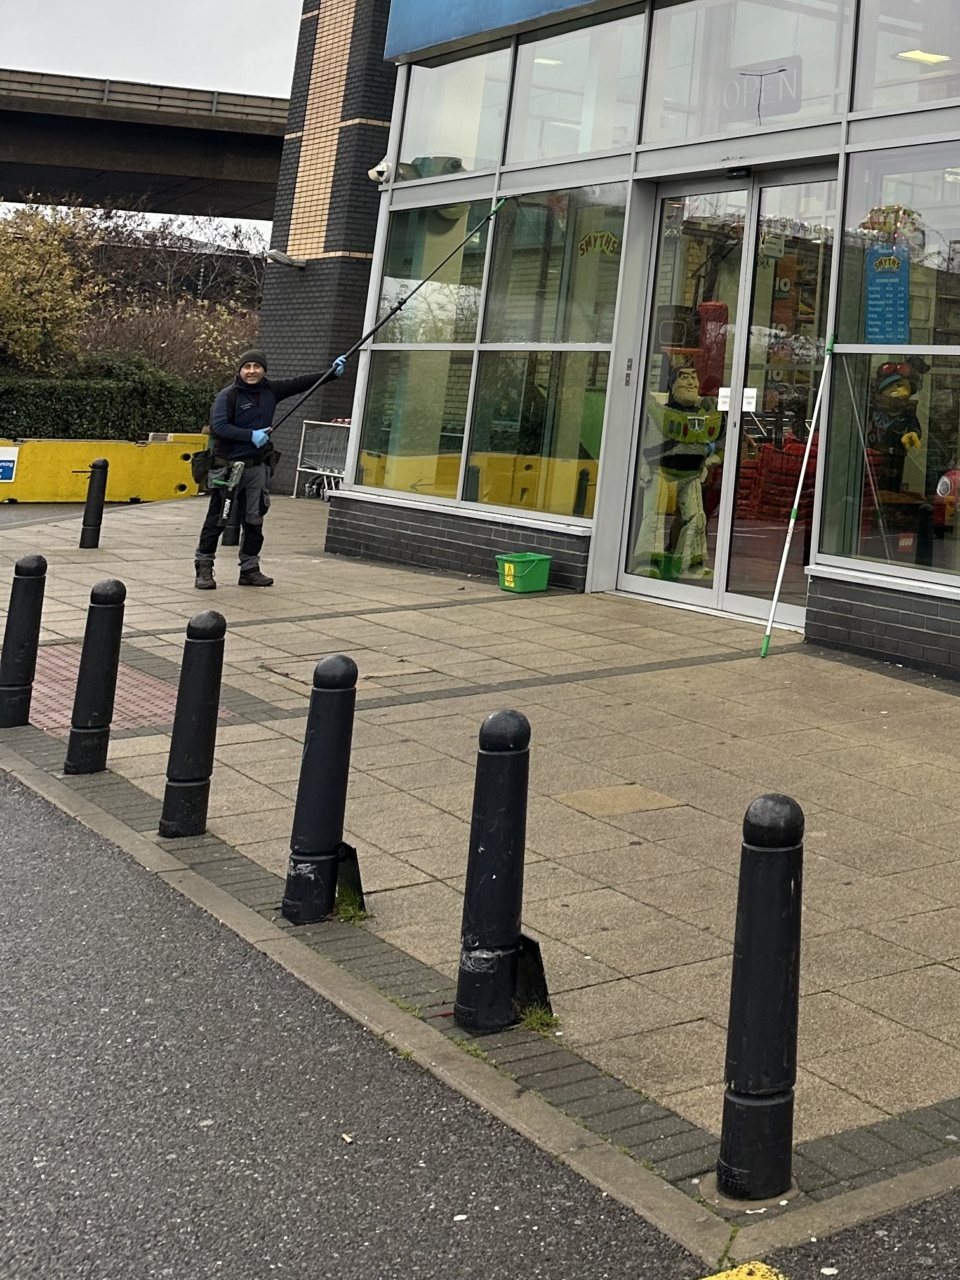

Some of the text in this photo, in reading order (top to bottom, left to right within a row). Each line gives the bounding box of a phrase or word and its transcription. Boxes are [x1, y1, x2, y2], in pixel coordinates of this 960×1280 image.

[723, 68, 798, 110] OPEN
[579, 233, 618, 257] SMYTHS
[874, 257, 900, 270] SMYTHS
